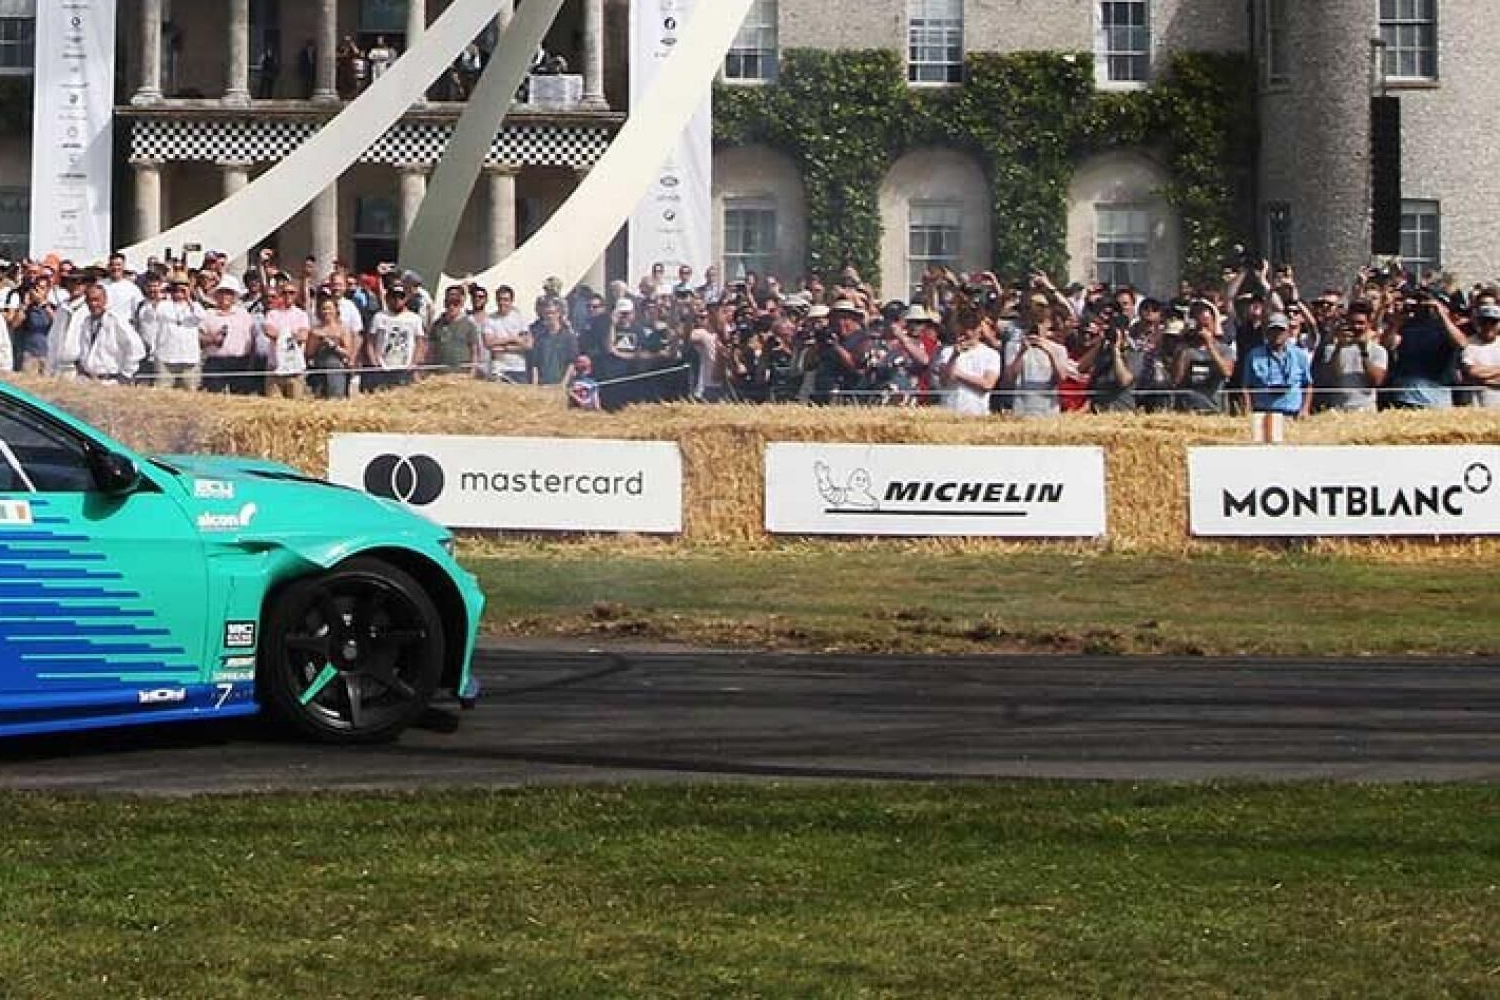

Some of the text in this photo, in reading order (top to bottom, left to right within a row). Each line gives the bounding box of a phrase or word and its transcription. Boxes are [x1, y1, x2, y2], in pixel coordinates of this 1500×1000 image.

[460, 471, 644, 495] mastercard
[884, 482, 1064, 503] MICHELIN
[1222, 485, 1463, 517] MONTBLANC
